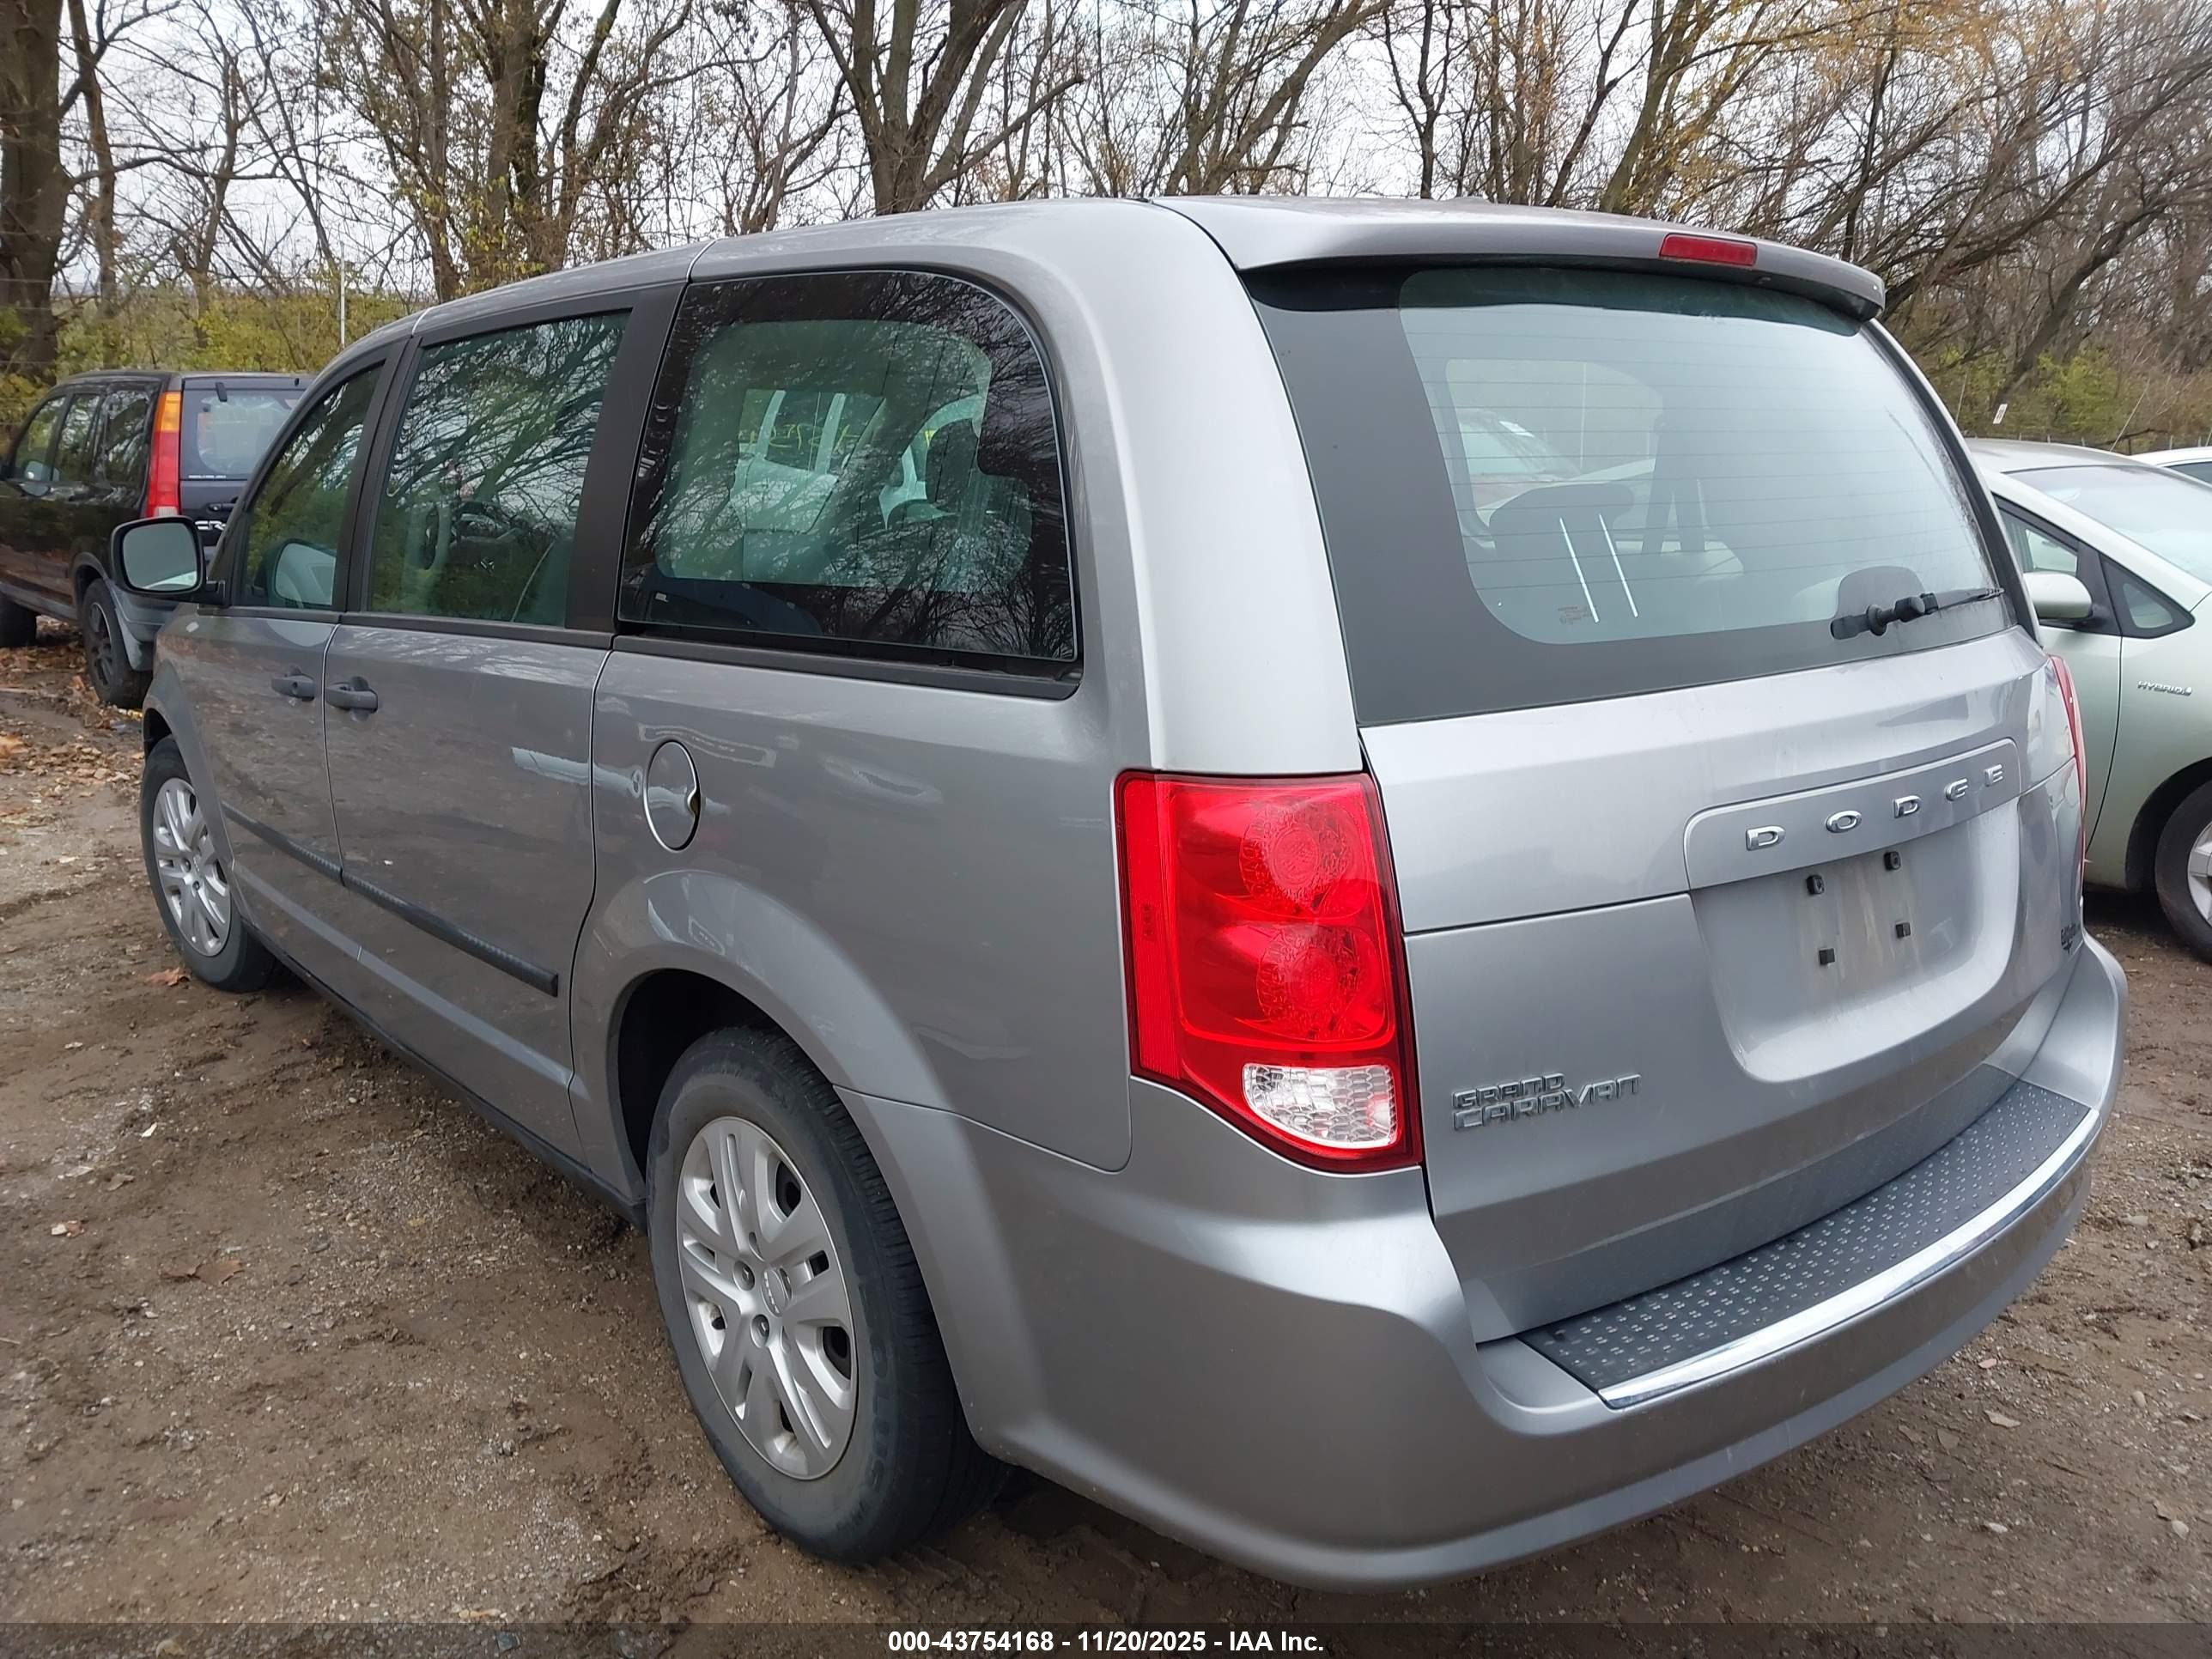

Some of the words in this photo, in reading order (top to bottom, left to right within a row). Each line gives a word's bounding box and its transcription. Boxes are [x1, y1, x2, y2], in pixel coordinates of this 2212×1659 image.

[1746, 764, 2004, 852] DODGE
[1452, 1073, 1565, 1109] GRAND
[1453, 1073, 1642, 1132] CARAVAN
